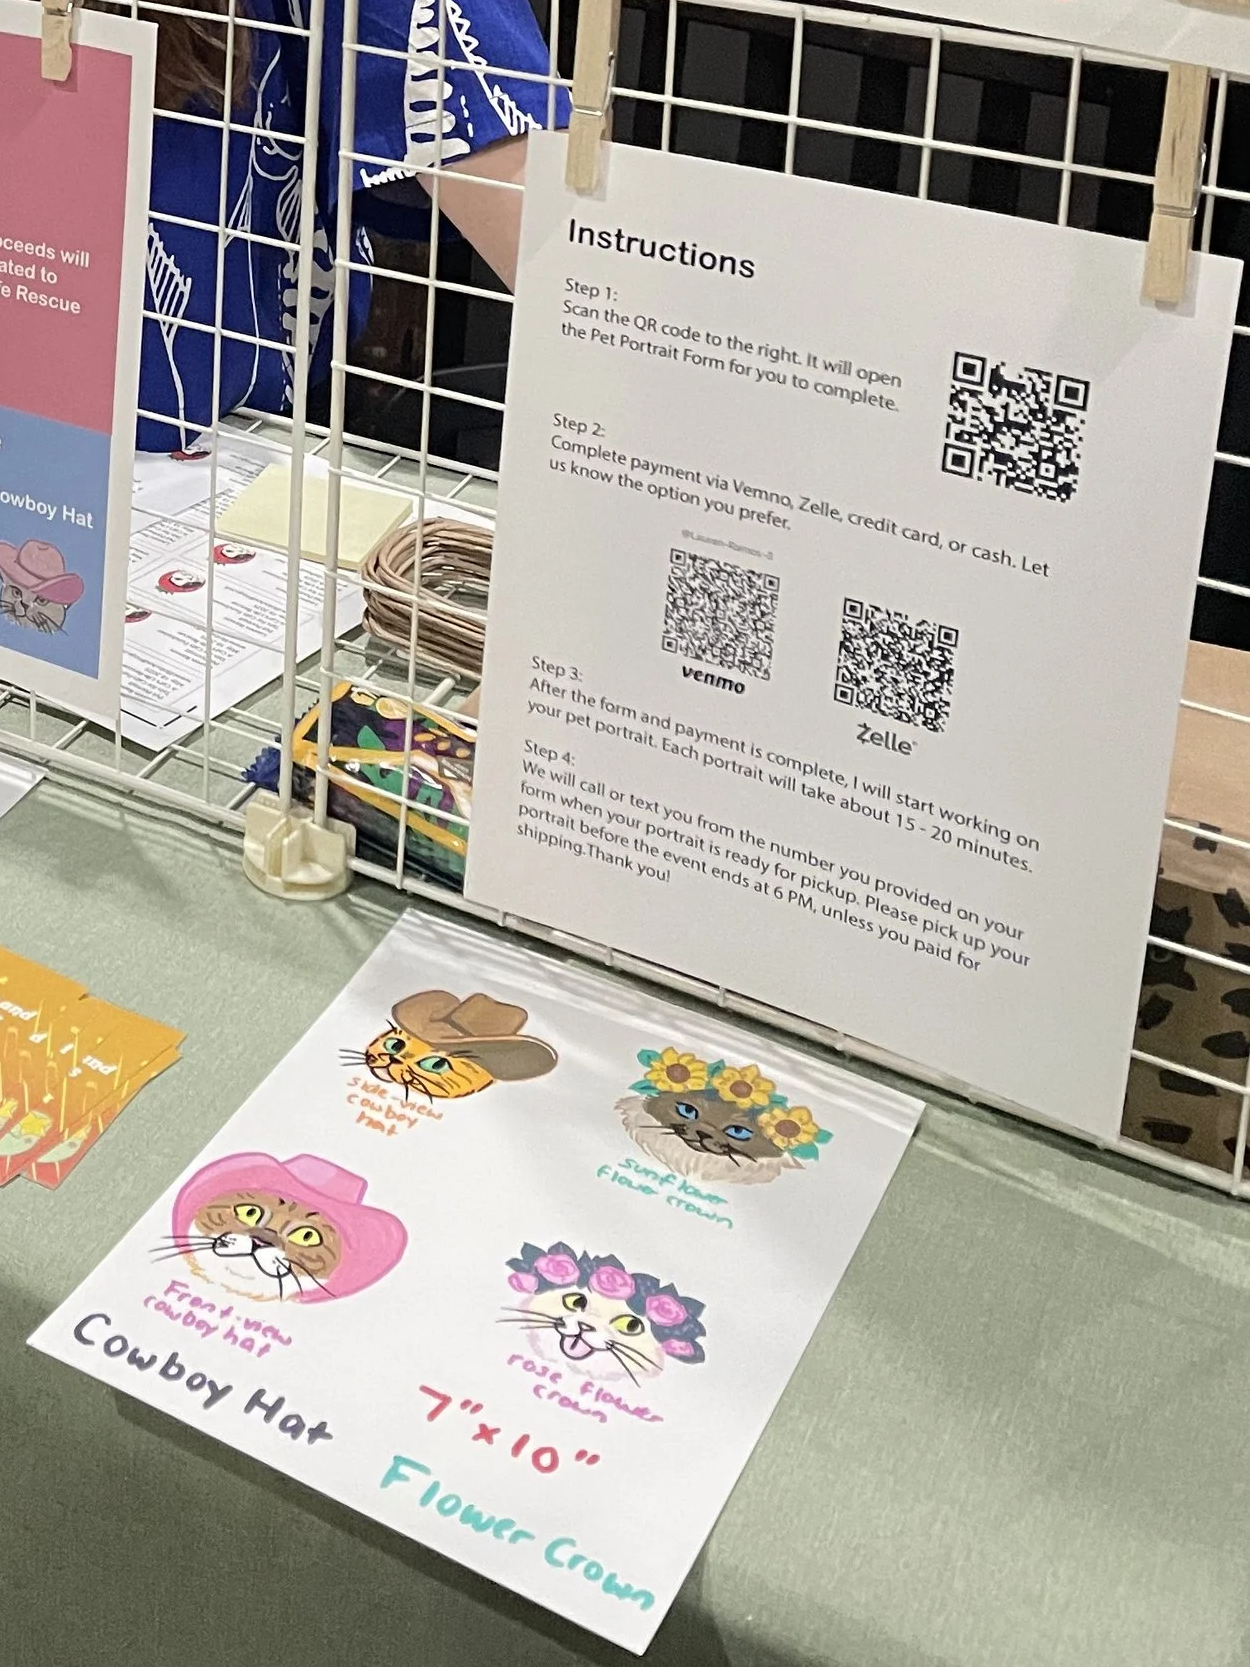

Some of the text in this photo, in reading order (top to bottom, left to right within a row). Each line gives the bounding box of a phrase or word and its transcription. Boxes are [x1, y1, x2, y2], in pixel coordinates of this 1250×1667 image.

[59, 249, 89, 268] will
[568, 217, 755, 279] Instructions
[39, 265, 57, 284] to
[563, 276, 618, 302] Step 1:
[15, 283, 81, 314] Rescue
[561, 298, 902, 388] Scan the QR code to the right. It will open
[561, 321, 899, 412] the Pet Portrait Form for you to complete.
[551, 411, 606, 438] Step 2:
[548, 457, 791, 531] us know the option you prefer.
[550, 433, 1050, 578] Complete payment via Vemno, Zelle, credit card, or cash. Let
[61, 504, 93, 529] Hat
[530, 654, 583, 682] Step 3:
[681, 664, 746, 695] venmo
[523, 738, 575, 767] Step 4:
[855, 721, 914, 756] Zelle
[528, 676, 1039, 852] After the form and payment is complete, I will start working on
[72, 1312, 335, 1446] Cowboy Hat
[506, 1351, 562, 1385] rose
[380, 1453, 656, 1612] Flower Crown
